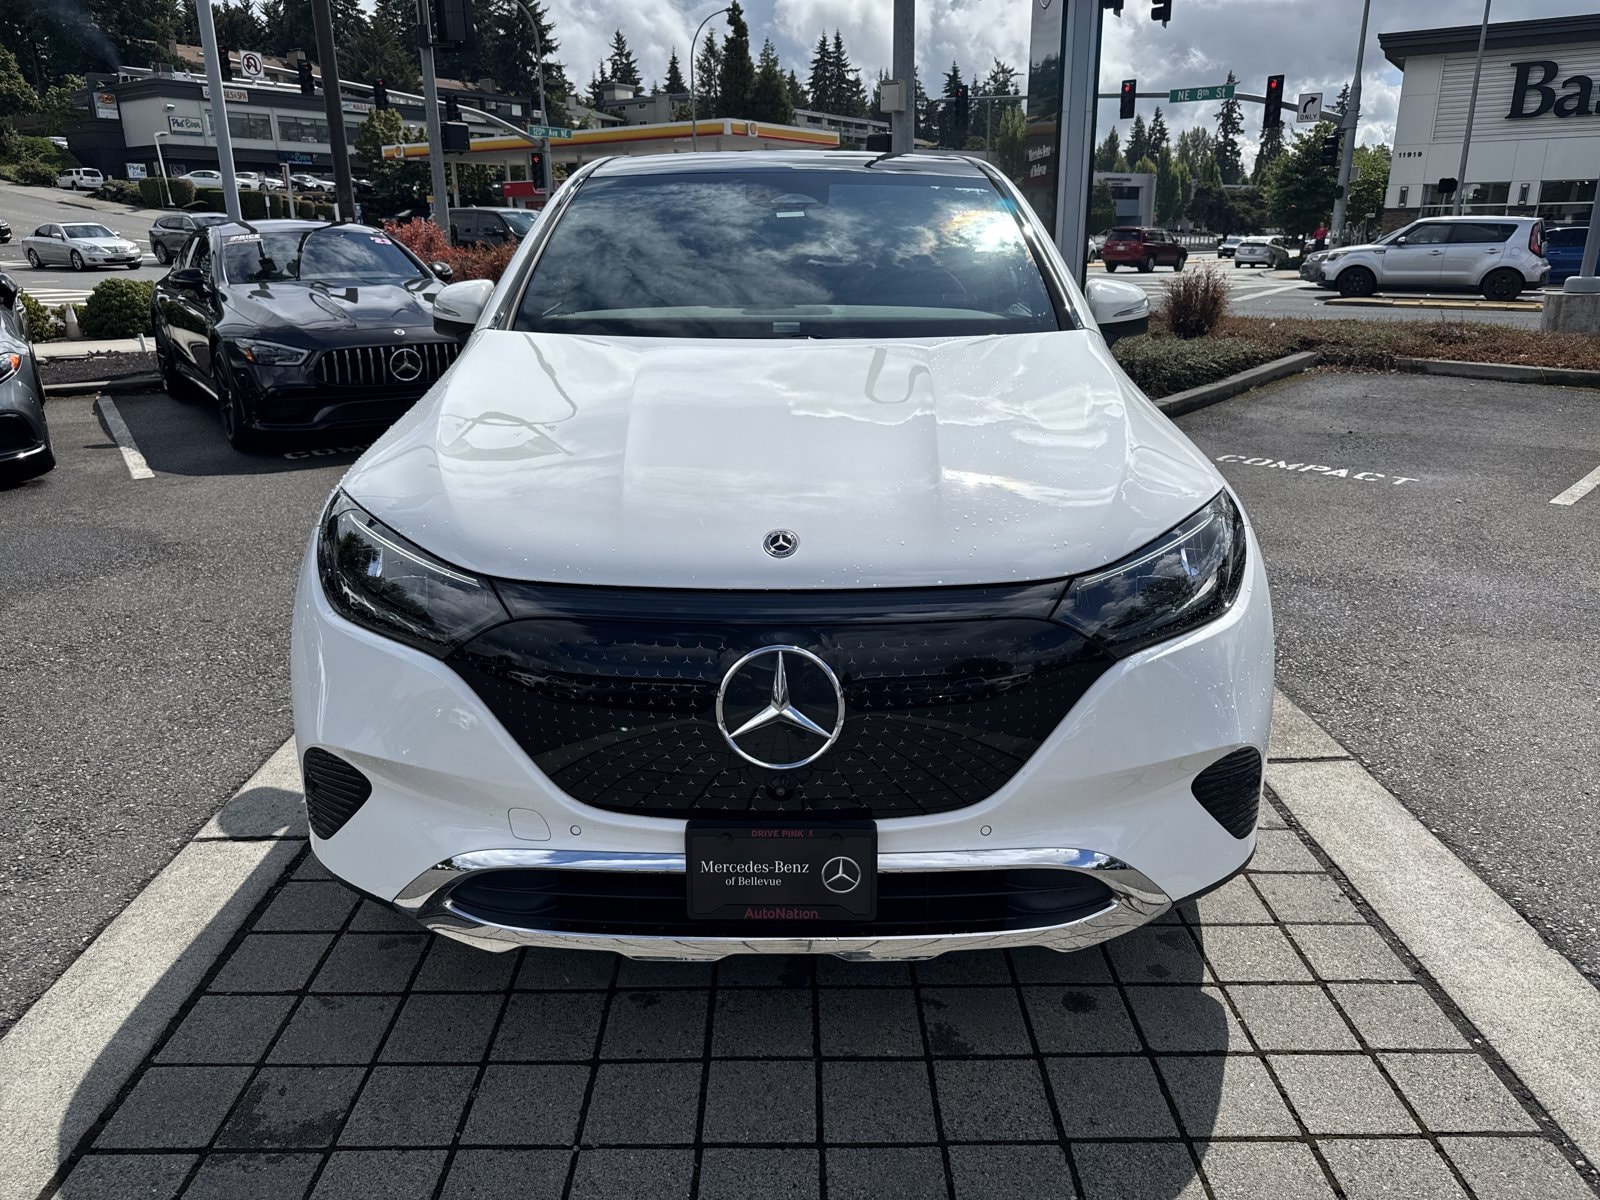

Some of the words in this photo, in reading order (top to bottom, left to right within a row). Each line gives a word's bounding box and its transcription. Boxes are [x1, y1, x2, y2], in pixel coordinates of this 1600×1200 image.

[1177, 90, 1190, 101] NE
[1197, 88, 1210, 99] 8th
[1215, 87, 1226, 98] St
[1300, 113, 1318, 121] ONLY
[533, 128, 546, 137] 120th
[548, 129, 558, 137] Ave
[561, 130, 568, 138] NE
[283, 444, 370, 460] COM
[1215, 454, 1419, 486] COMPACT
[751, 829, 780, 838] DRIVE
[781, 829, 805, 838] PINK
[700, 860, 810, 874] Mercedes-Benz
[725, 876, 736, 886] of
[738, 876, 782, 886] Bellevue
[744, 907, 819, 920] AutoNation
